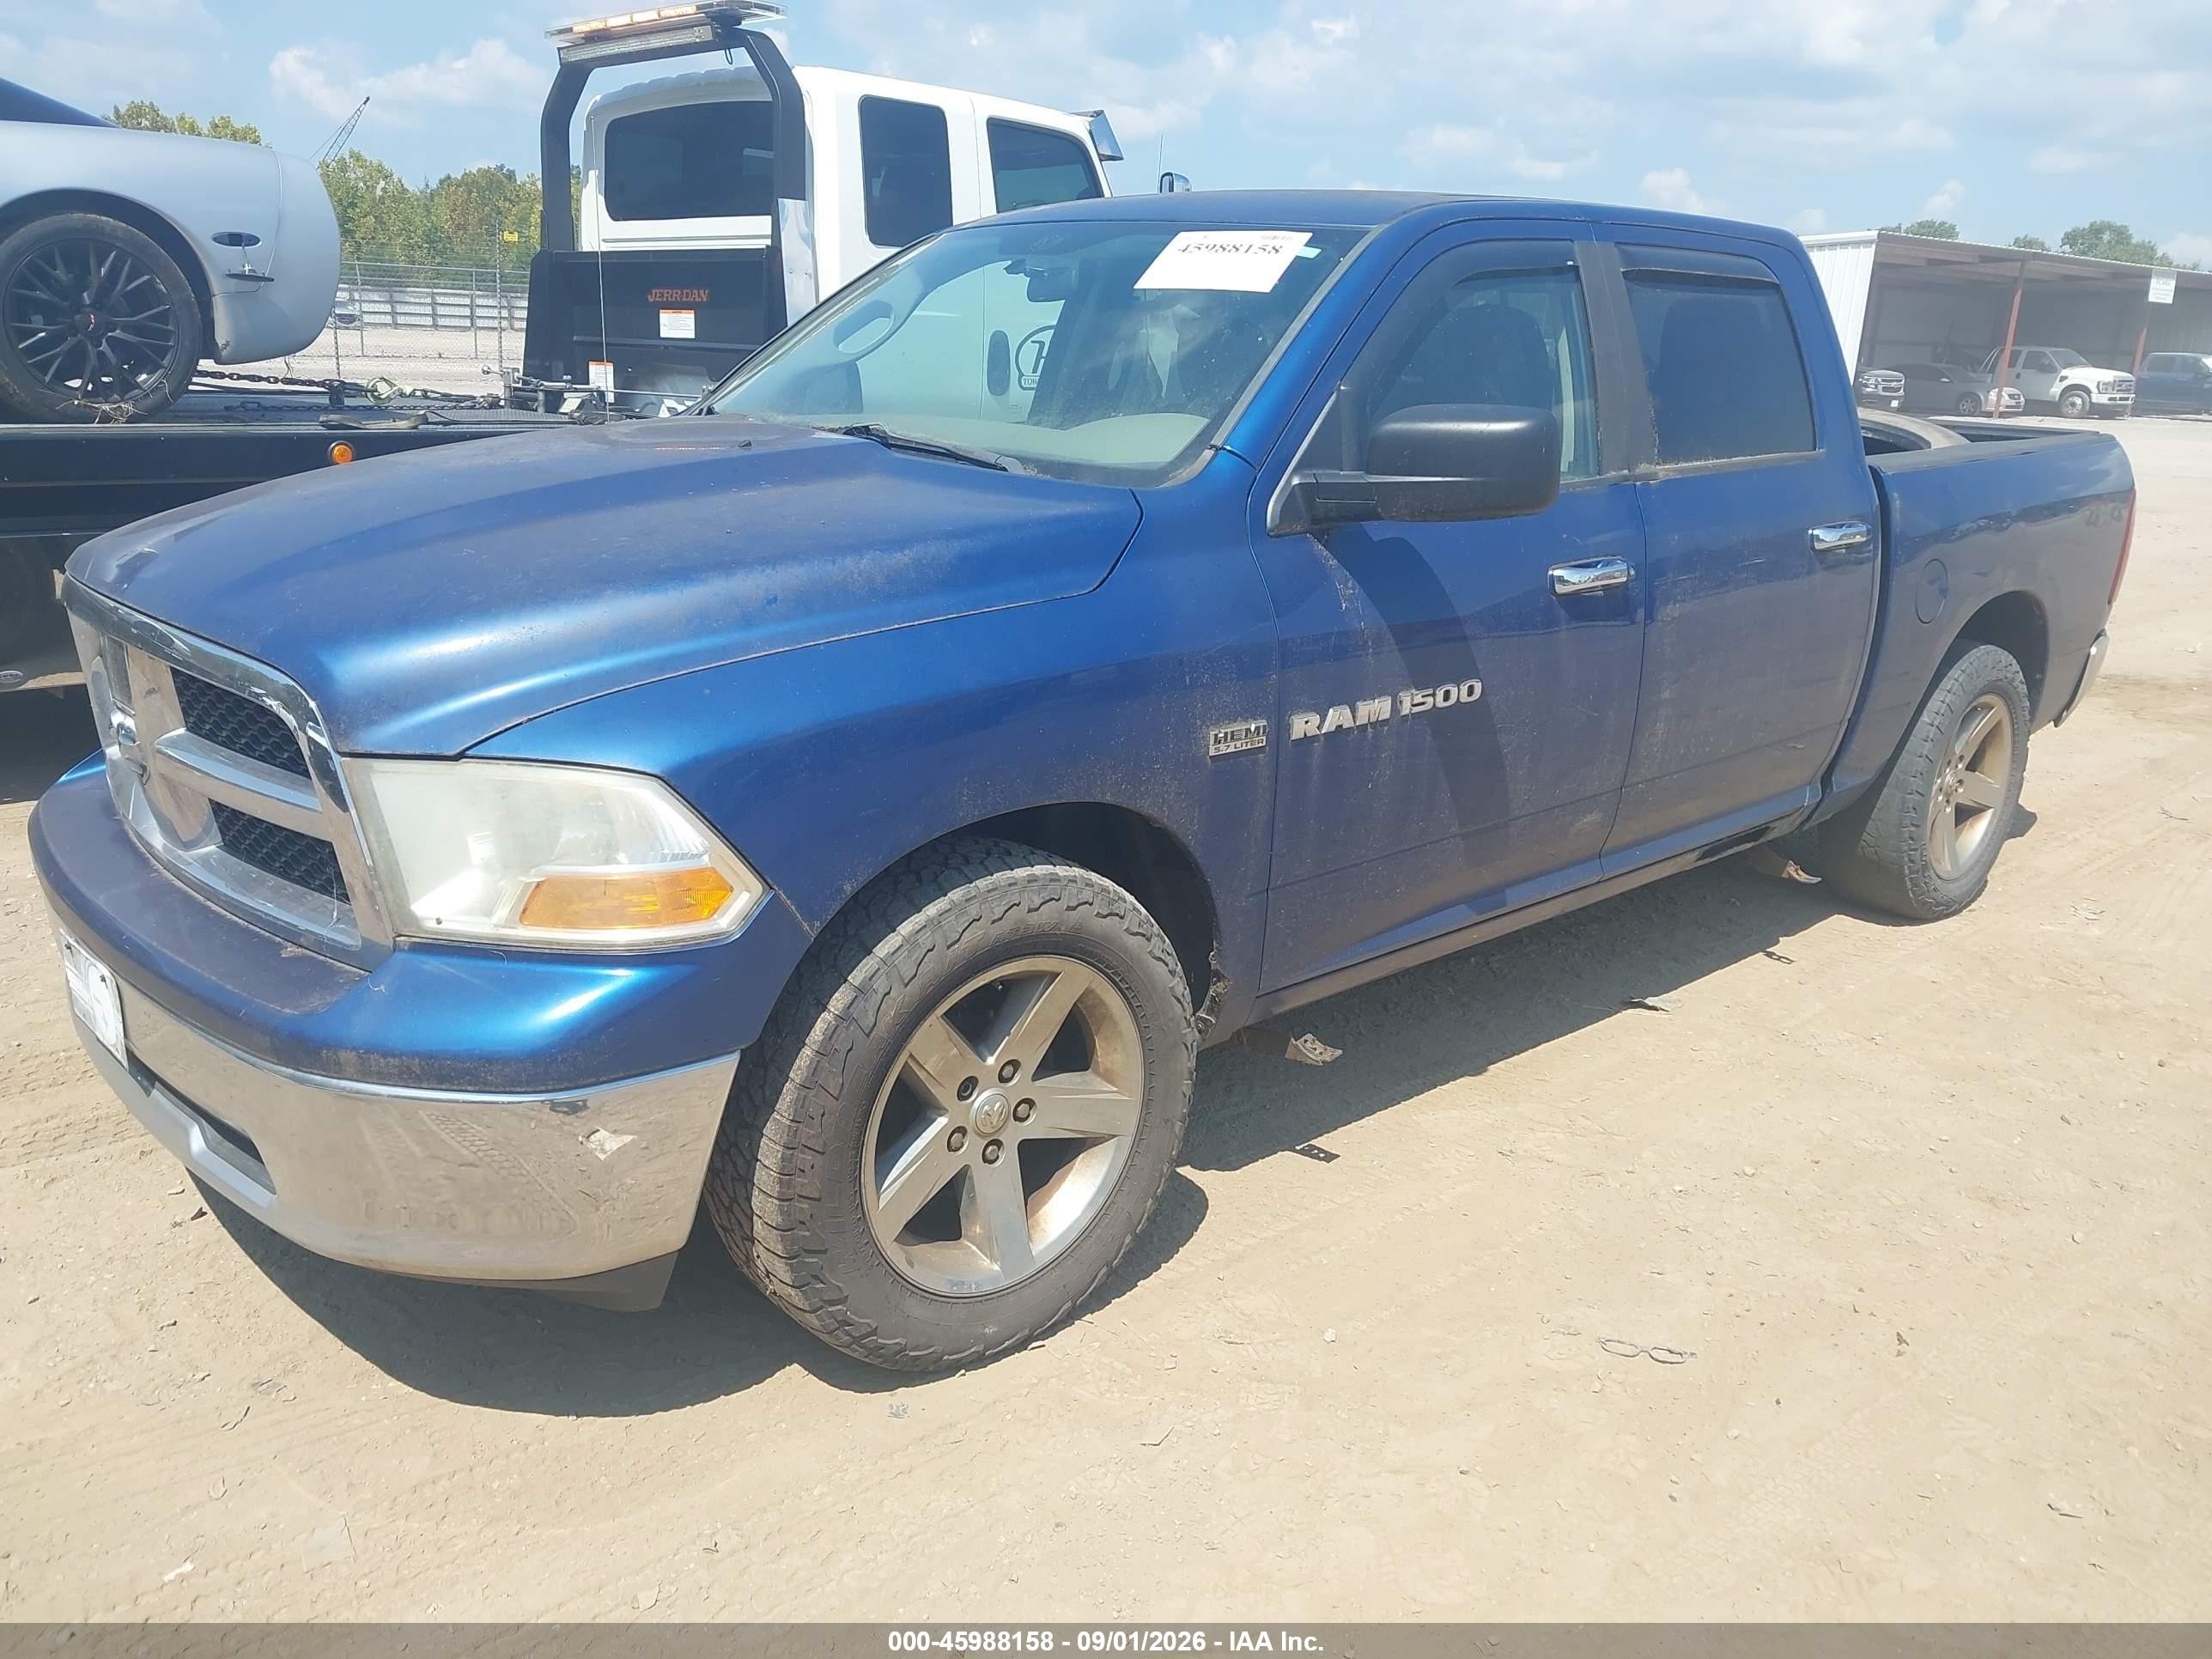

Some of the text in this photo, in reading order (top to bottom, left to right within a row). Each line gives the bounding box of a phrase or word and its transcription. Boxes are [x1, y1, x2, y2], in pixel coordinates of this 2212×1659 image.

[1177, 243, 1283, 255] 45988158
[1290, 678, 1483, 741] RAM 1500
[1212, 724, 1267, 745] HEMI
[1213, 738, 1265, 754] 5.7 LITER
